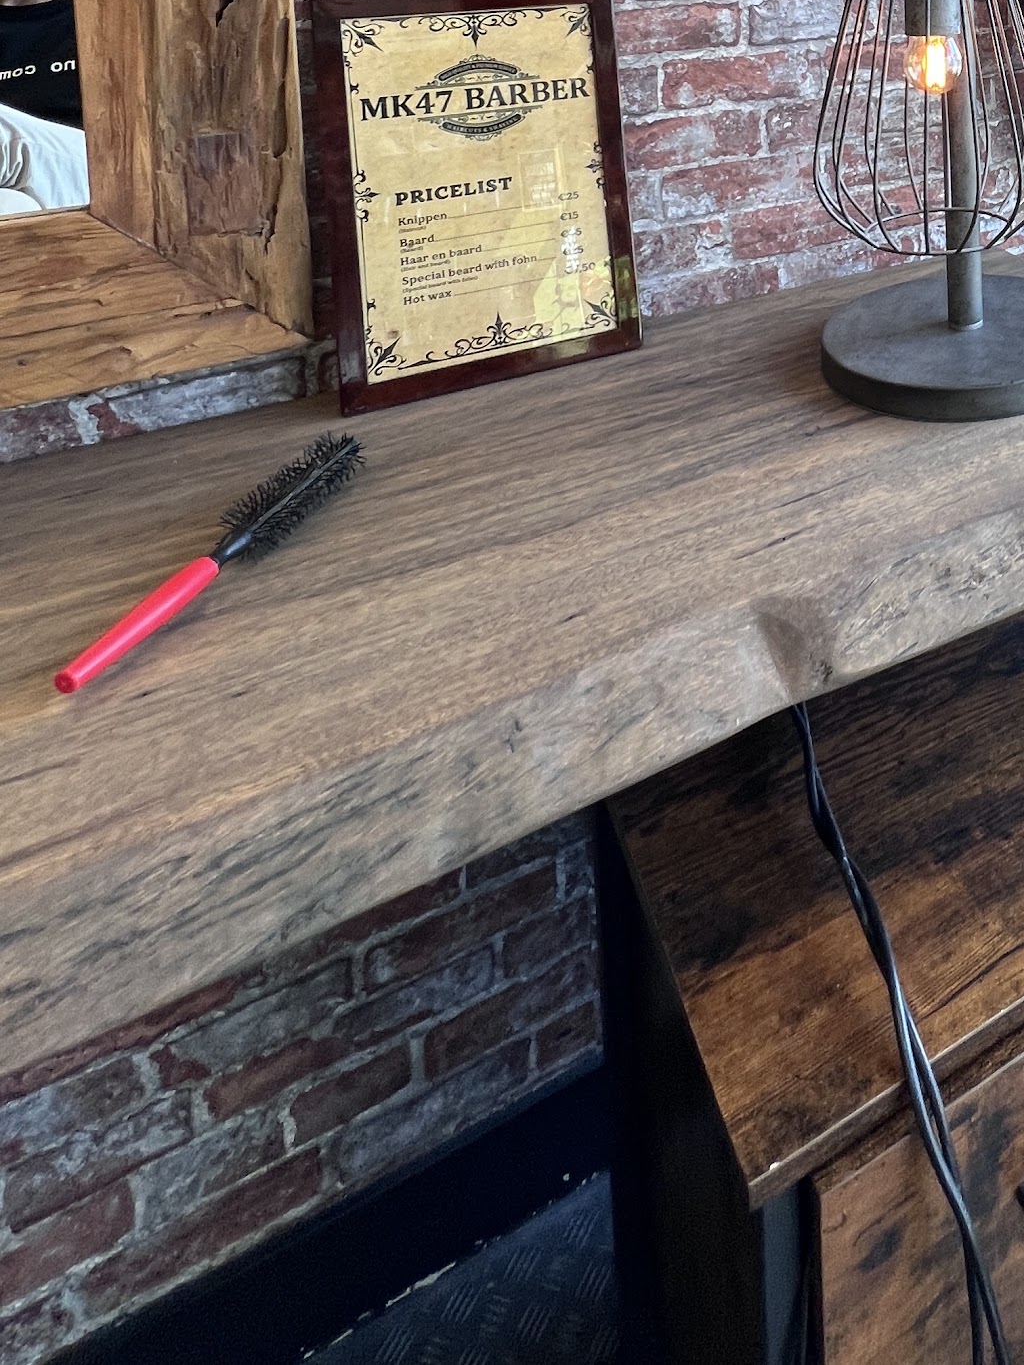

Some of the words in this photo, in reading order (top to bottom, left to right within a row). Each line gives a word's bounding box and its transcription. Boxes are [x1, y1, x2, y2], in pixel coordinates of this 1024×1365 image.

[360, 90, 453, 122] MK47
[464, 77, 591, 111] BARBER
[394, 176, 512, 207] PRICELIST
[398, 213, 447, 227] Knippen
[558, 190, 579, 202] €25
[400, 234, 435, 248] Baard
[560, 210, 579, 221] €15
[400, 255, 428, 266] Haar
[431, 252, 446, 261] en
[449, 244, 482, 258] baard
[560, 227, 582, 238] €5
[402, 270, 445, 287] Special
[448, 264, 482, 277] beard
[485, 258, 509, 270] with
[512, 255, 537, 266] fohn
[403, 295, 425, 306] Hot
[428, 290, 452, 301] wax
